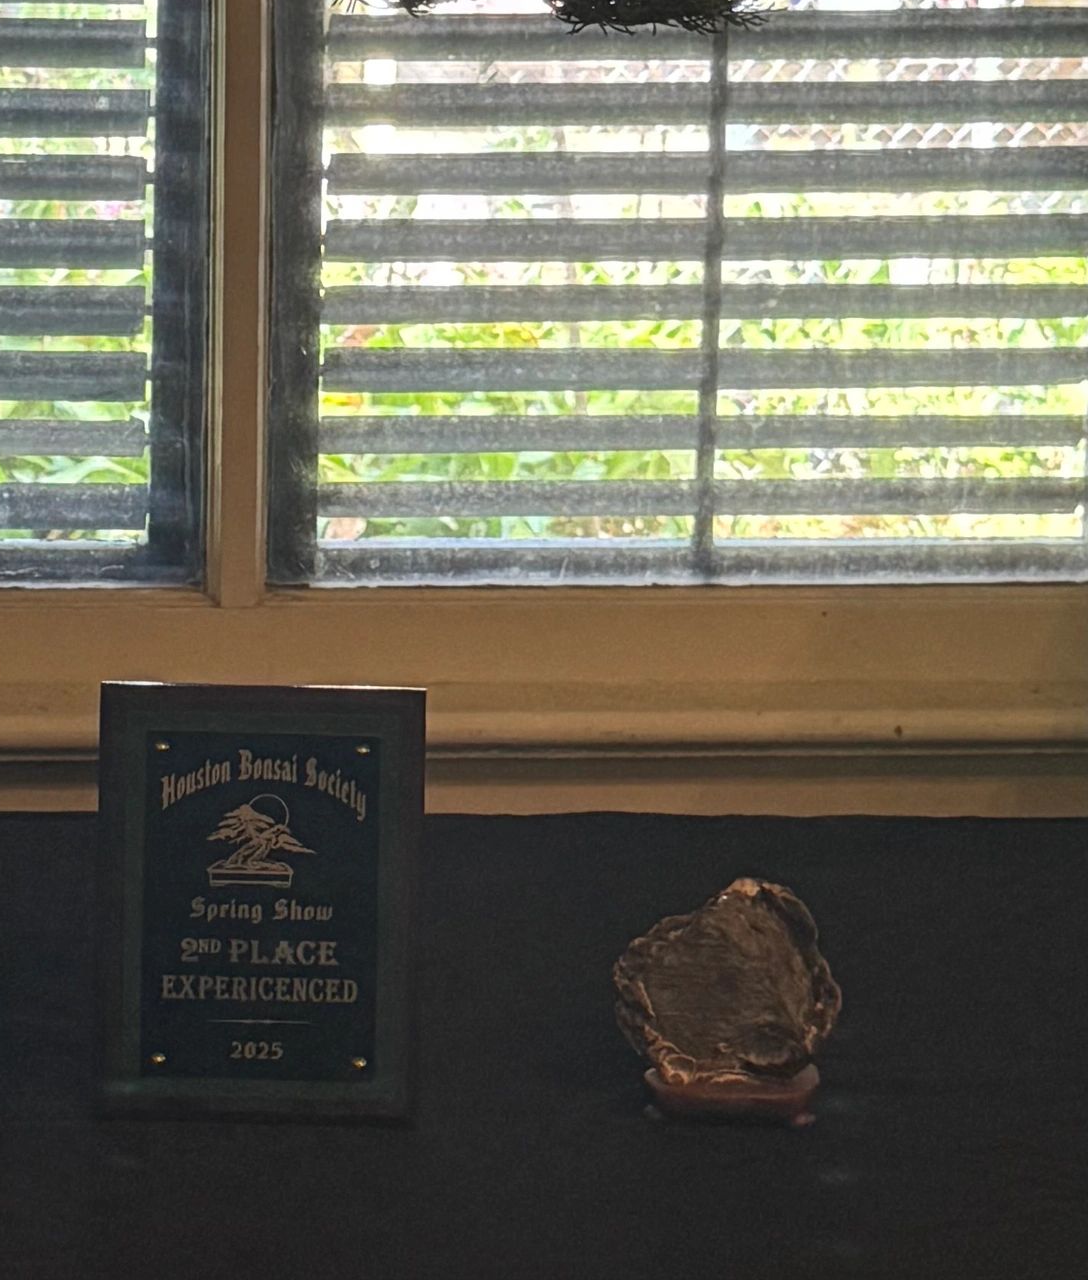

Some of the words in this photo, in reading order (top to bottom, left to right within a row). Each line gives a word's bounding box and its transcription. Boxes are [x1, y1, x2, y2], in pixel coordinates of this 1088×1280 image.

[161, 759, 231, 810] Houston
[238, 749, 298, 783] Bonsai
[304, 757, 366, 822] Society
[190, 896, 262, 924] Spring
[273, 898, 333, 921] Show
[180, 937, 222, 963] 2ND
[229, 939, 339, 966] PLACE
[162, 974, 359, 1003] EXPERICENCED
[230, 1041, 284, 1060] 2025
